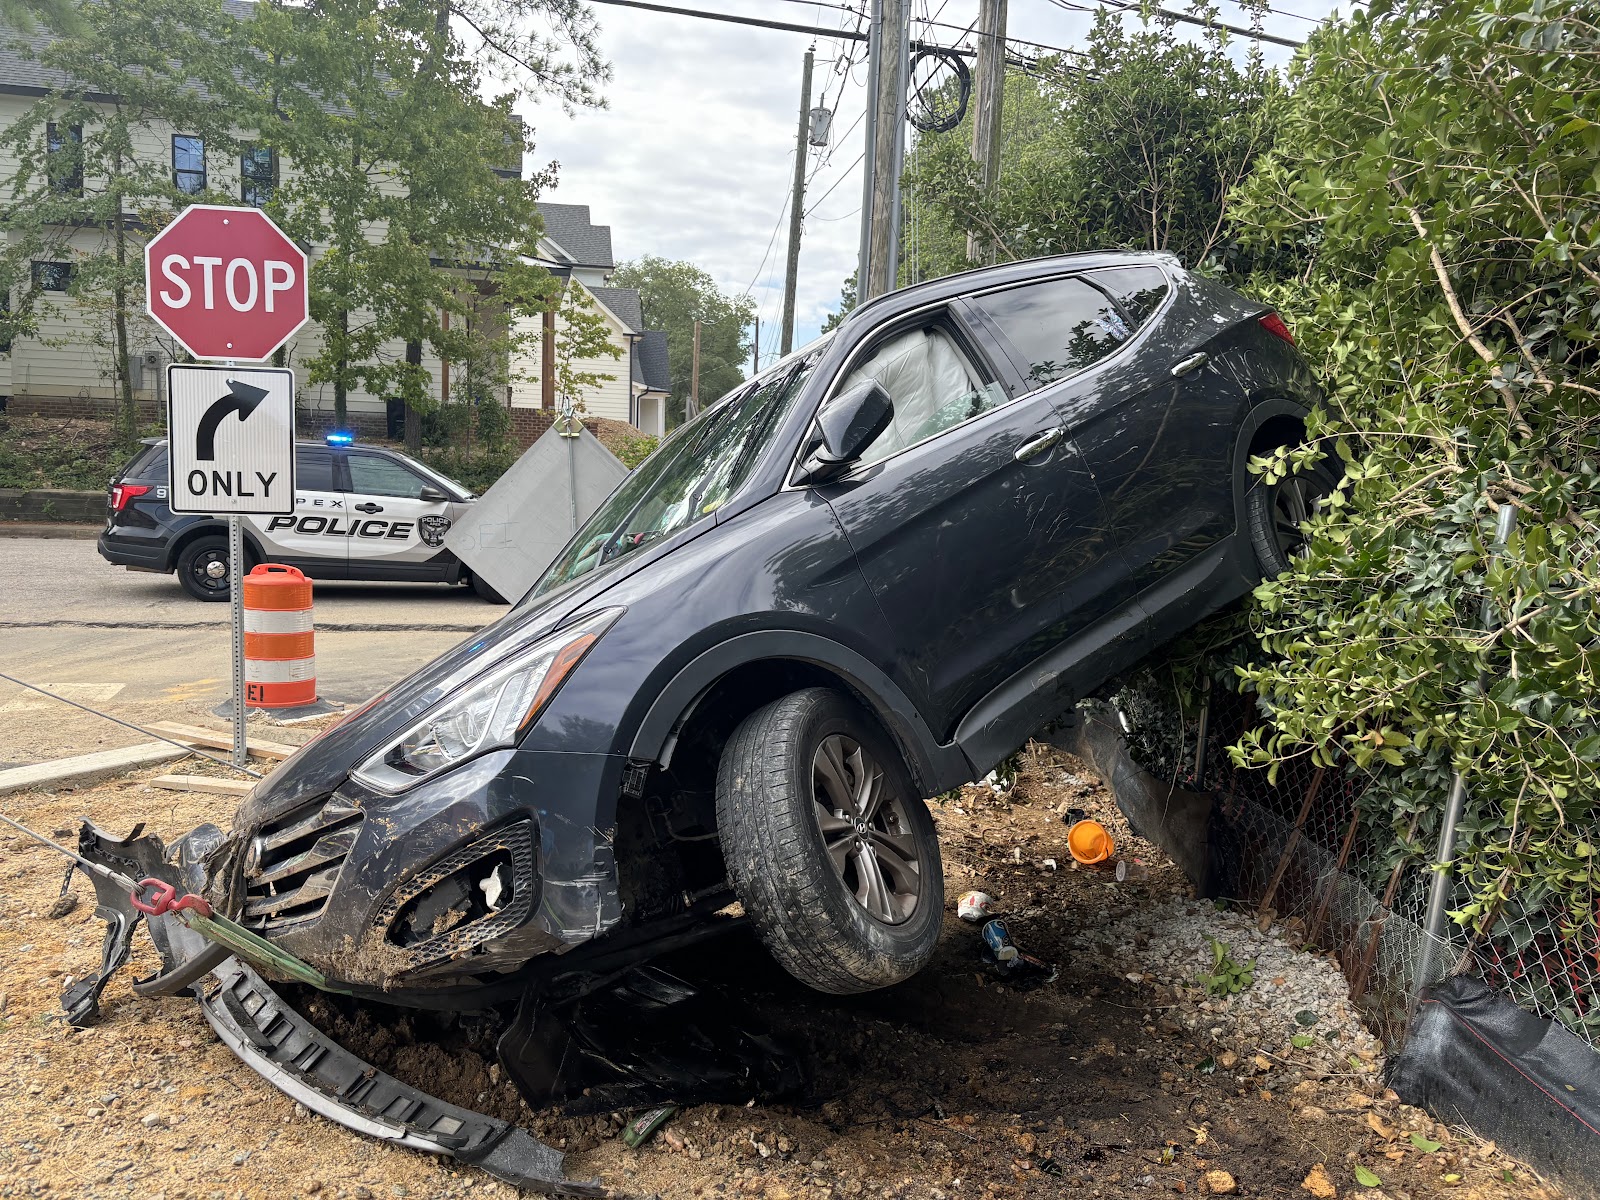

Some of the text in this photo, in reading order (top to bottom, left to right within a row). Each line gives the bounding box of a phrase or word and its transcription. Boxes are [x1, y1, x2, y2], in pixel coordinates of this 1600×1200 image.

[160, 254, 296, 312] STOP
[187, 469, 277, 497] ONLY
[295, 498, 344, 508] PEX
[265, 516, 415, 540] POLICE
[421, 516, 449, 525] POLICE
